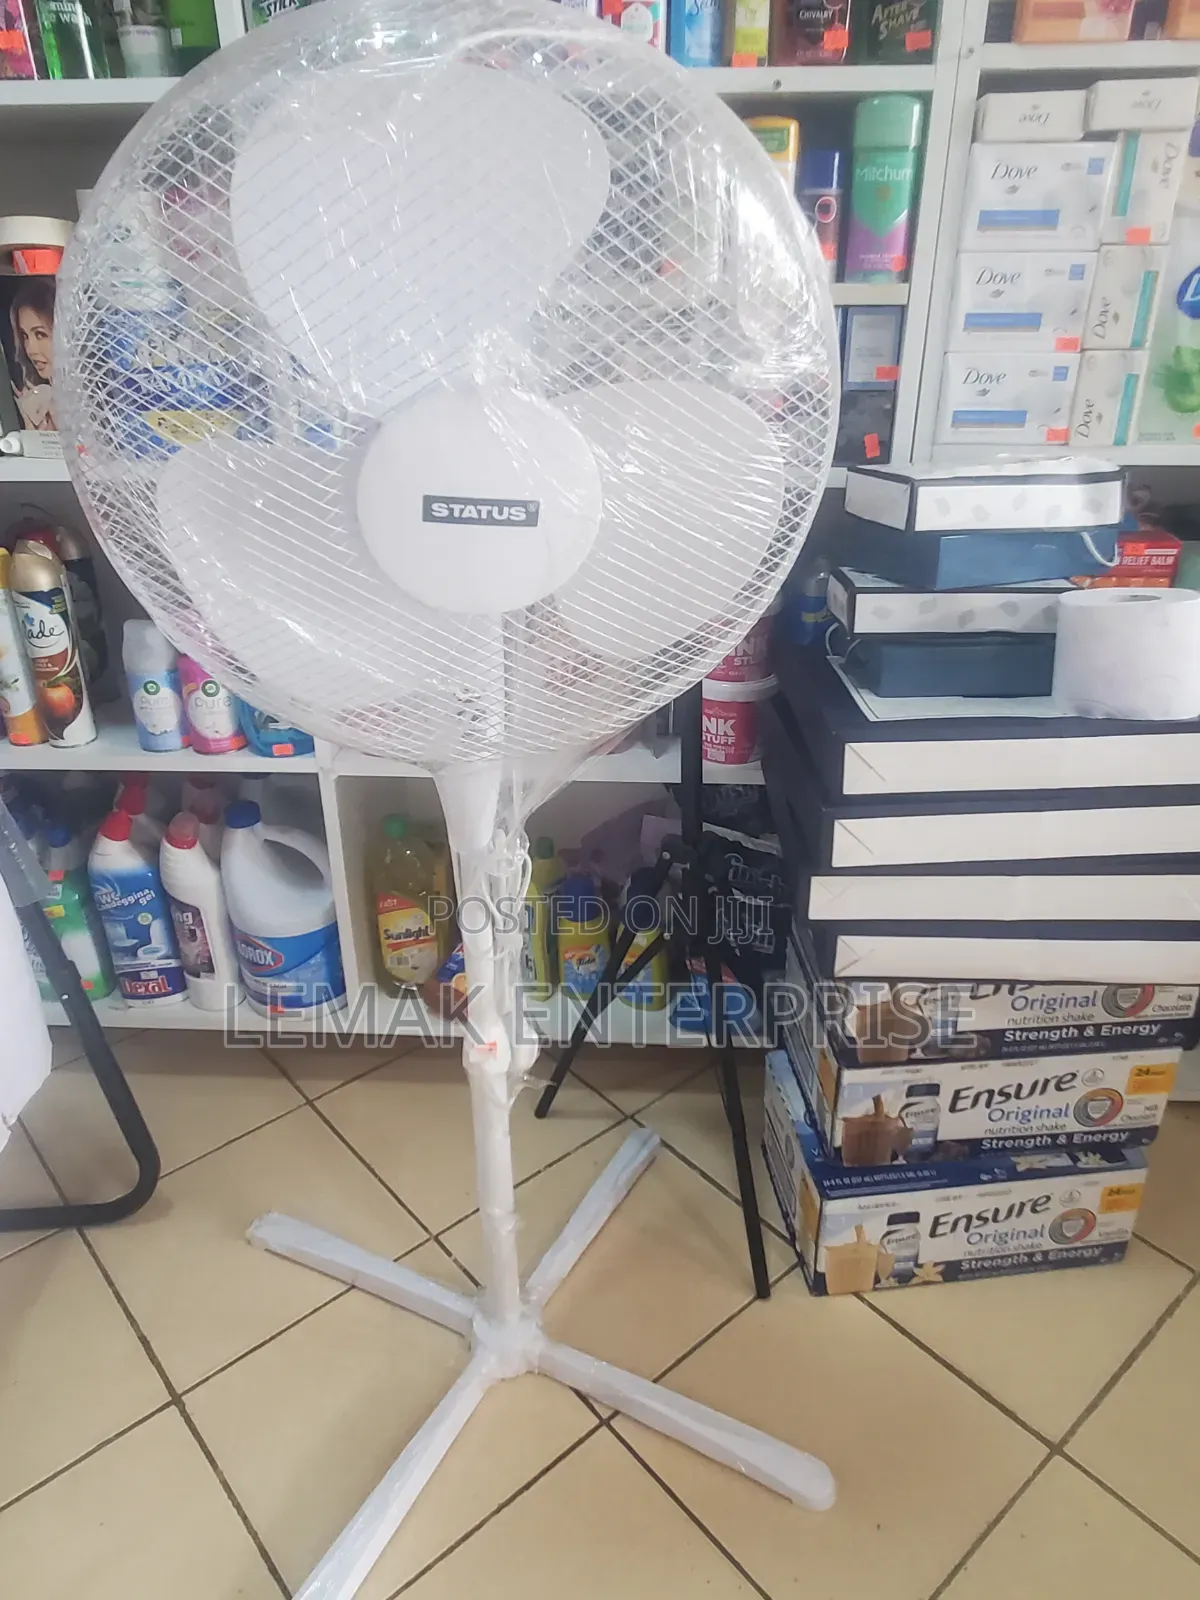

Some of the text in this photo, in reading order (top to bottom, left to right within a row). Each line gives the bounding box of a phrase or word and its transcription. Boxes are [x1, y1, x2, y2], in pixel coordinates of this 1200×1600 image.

[855, 165, 913, 182] Mitchum
[990, 160, 1038, 181] Dove
[975, 267, 1021, 286] Dove
[1093, 297, 1112, 339] Dove
[962, 367, 1006, 385] Dove
[1075, 398, 1095, 439] Dove
[430, 502, 527, 521] STATUS
[1121, 556, 1150, 566] RELIEF
[1150, 556, 1175, 566] BALM
[702, 716, 736, 736] NK
[138, 890, 156, 907] gel
[383, 925, 431, 940] Sunlight
[1010, 990, 1098, 1014] Original
[1006, 1012, 1095, 1026] nutrition shake
[1004, 1022, 1162, 1043] Strength & Energy
[948, 1070, 1077, 1114] Ensure
[988, 1103, 1070, 1124] Original
[984, 1122, 1067, 1136] nutrition shake
[981, 1130, 1129, 1150] Strength & Energy
[928, 1193, 1051, 1238] Ensure
[966, 1223, 1045, 1245] Original
[960, 1246, 1103, 1270] Strength & Energy
[963, 1241, 1044, 1257] nutrition shake
